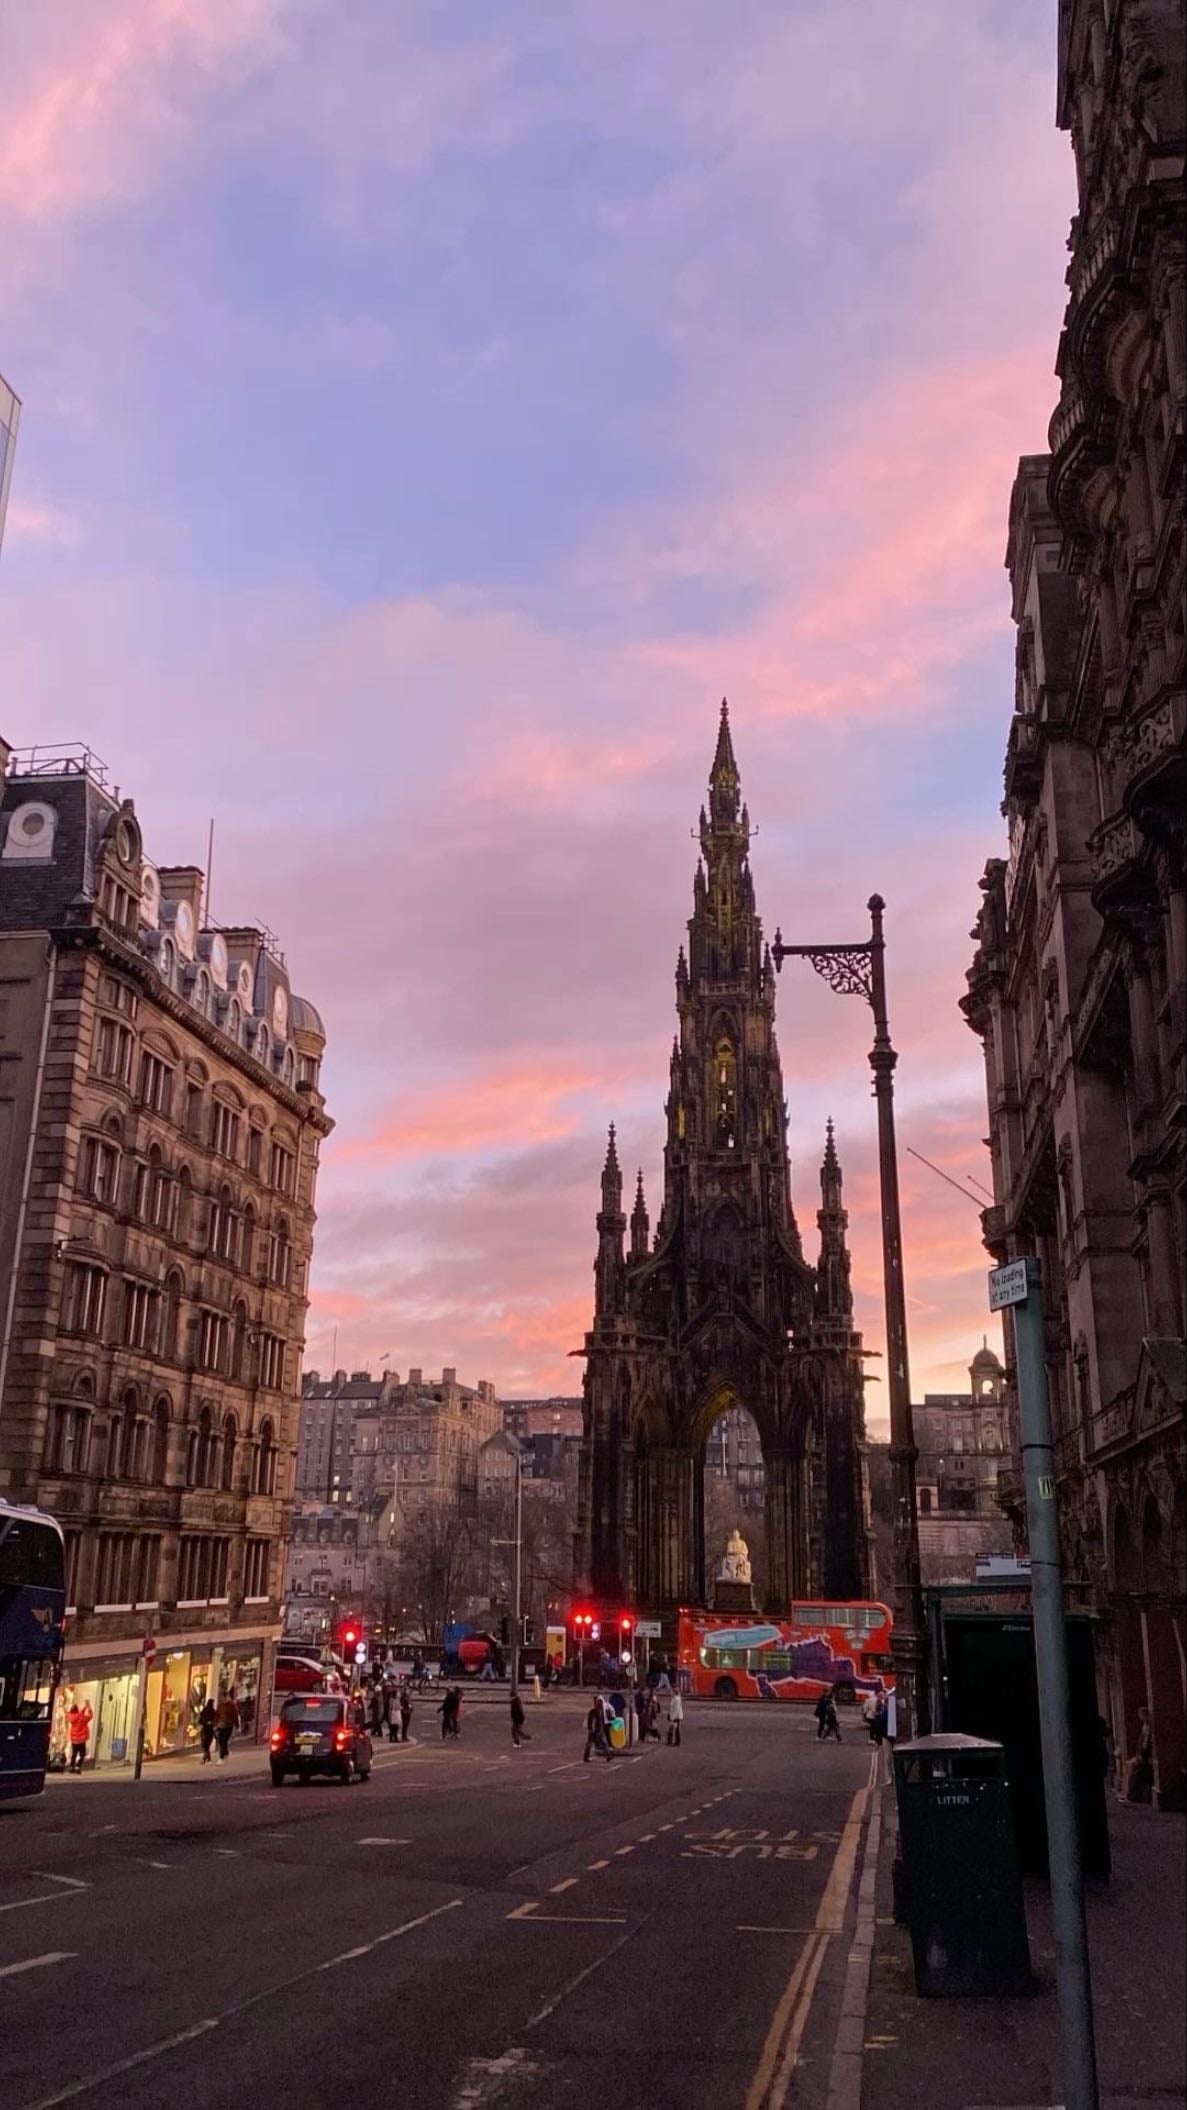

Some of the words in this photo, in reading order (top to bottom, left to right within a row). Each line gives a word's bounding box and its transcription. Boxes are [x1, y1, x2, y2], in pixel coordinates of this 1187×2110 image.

[937, 1795, 970, 1805] LITTER
[684, 1828, 843, 1843] STOP
[679, 1844, 818, 1860] BUS
